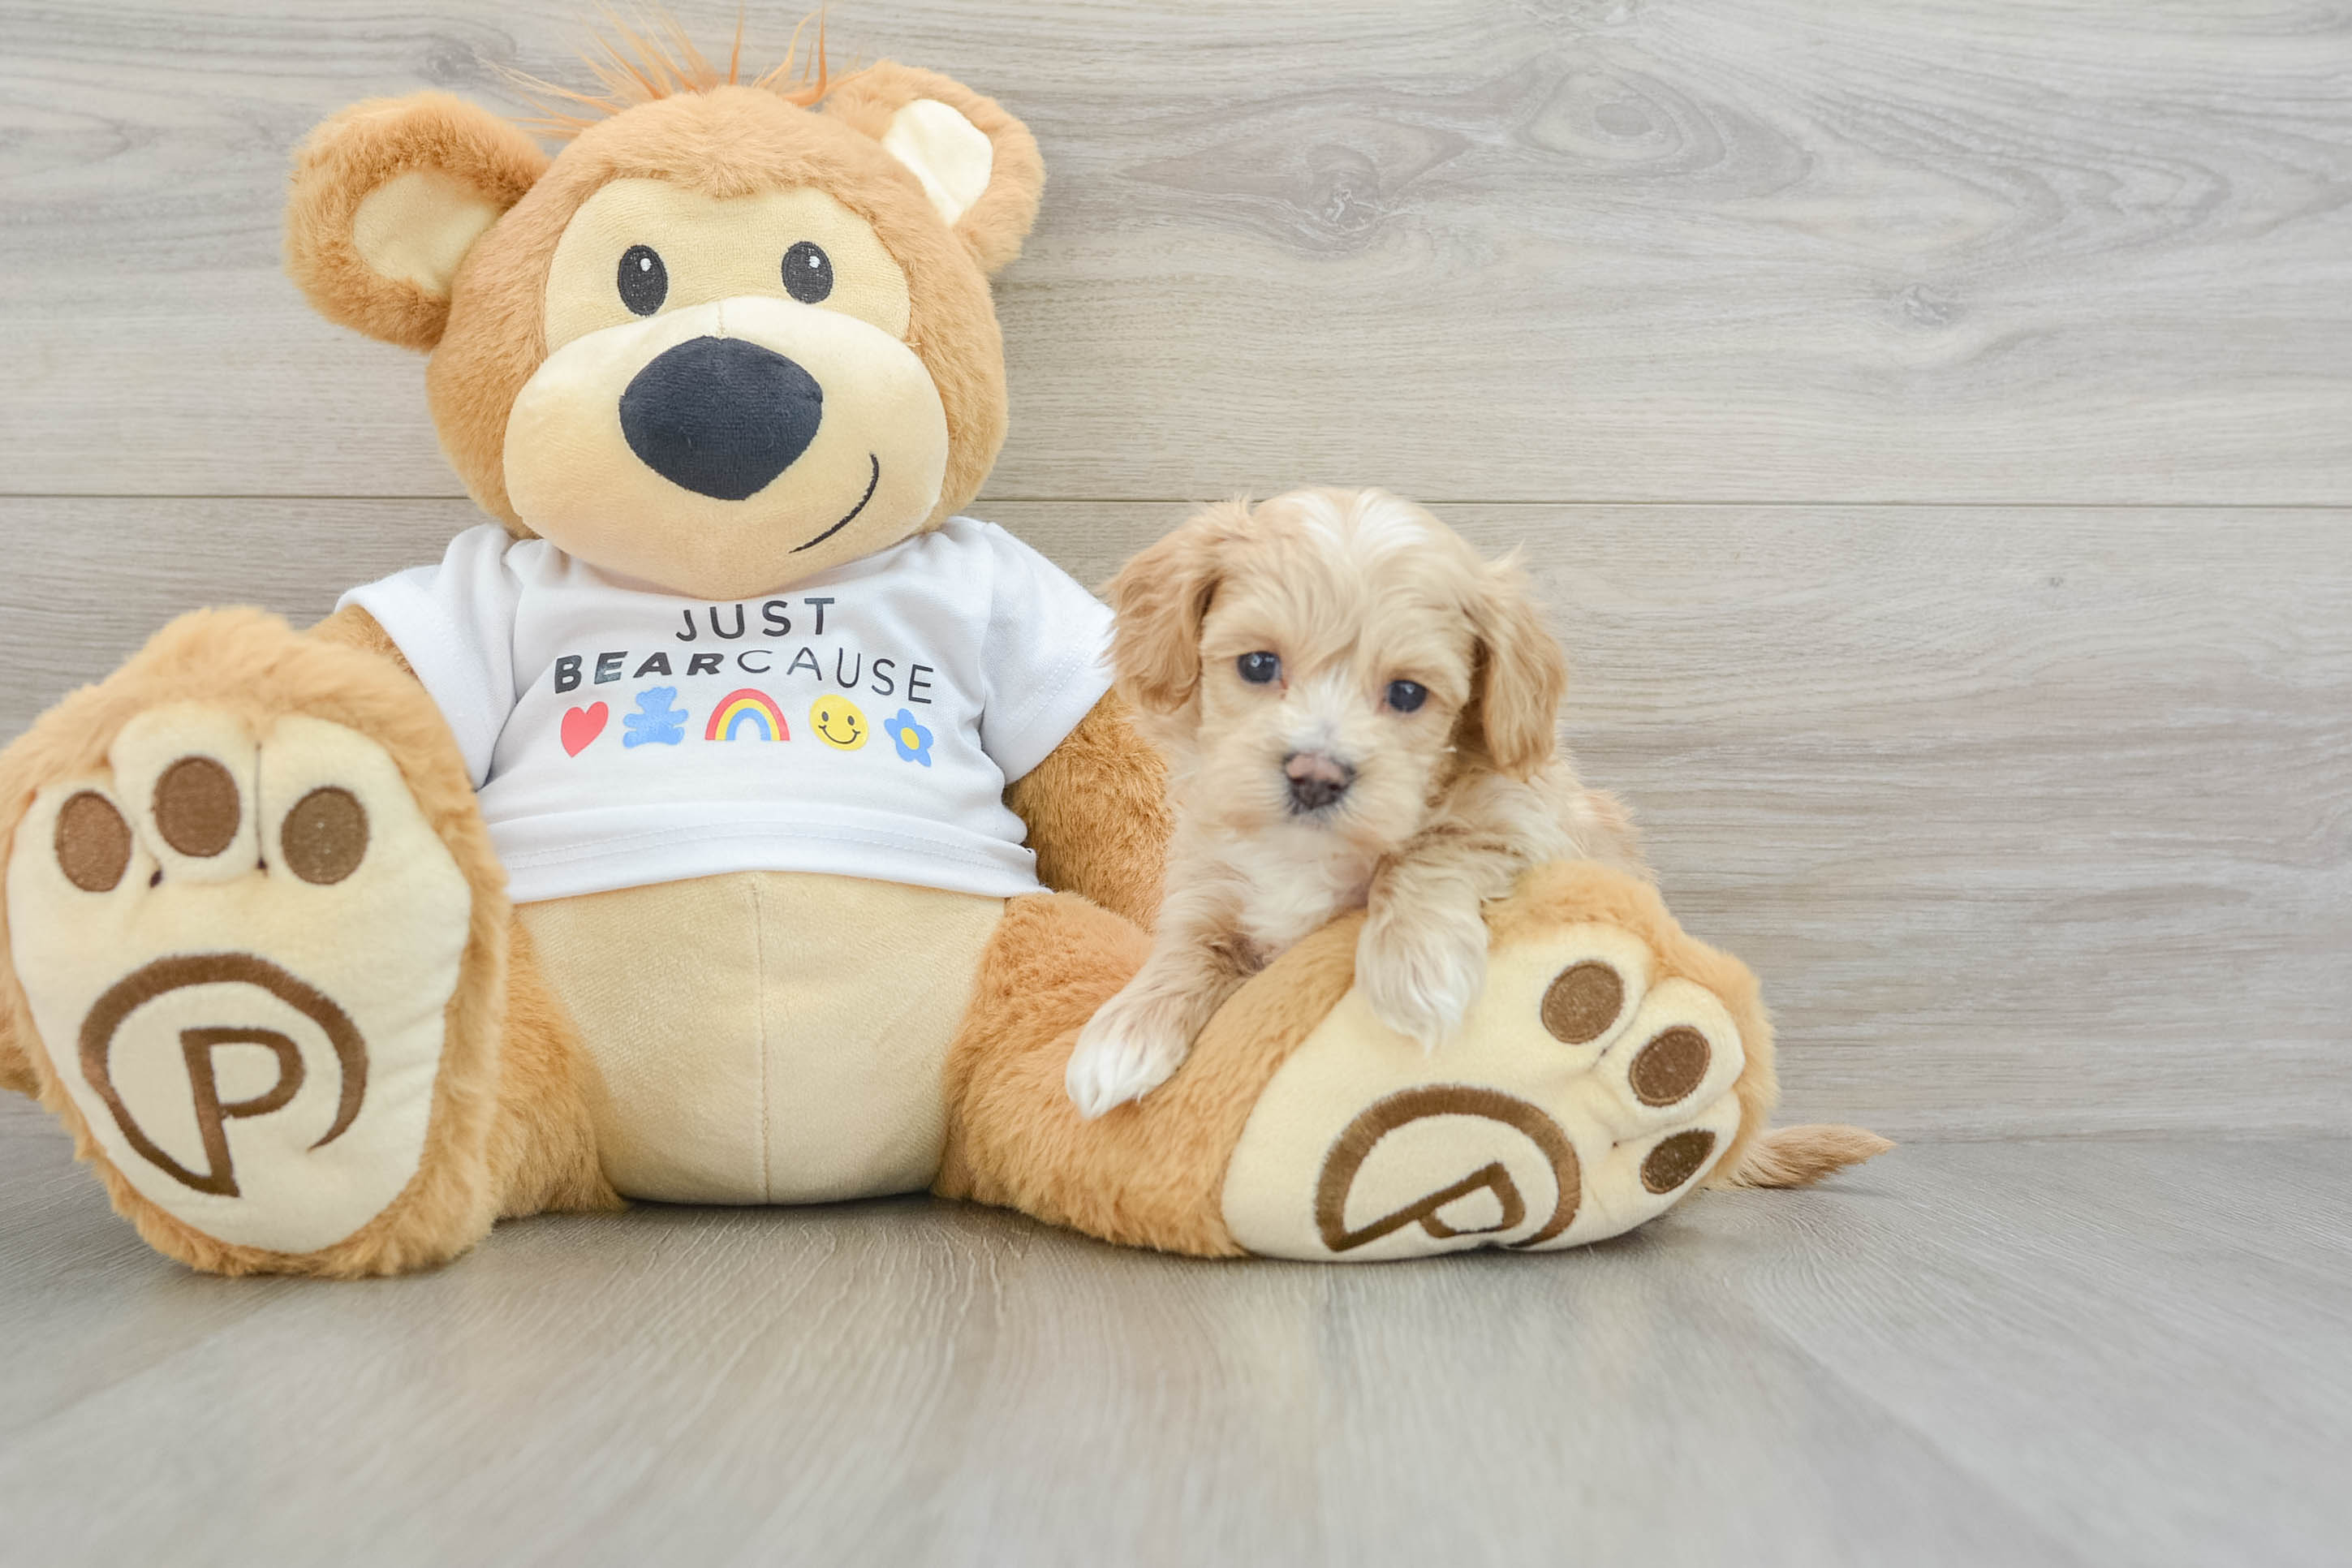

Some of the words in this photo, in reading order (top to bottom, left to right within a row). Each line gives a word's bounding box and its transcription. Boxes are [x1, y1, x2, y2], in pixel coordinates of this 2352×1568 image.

[675, 597, 835, 642] JUST
[554, 647, 935, 704] BEARCAUSE
[179, 1026, 307, 1199] P
